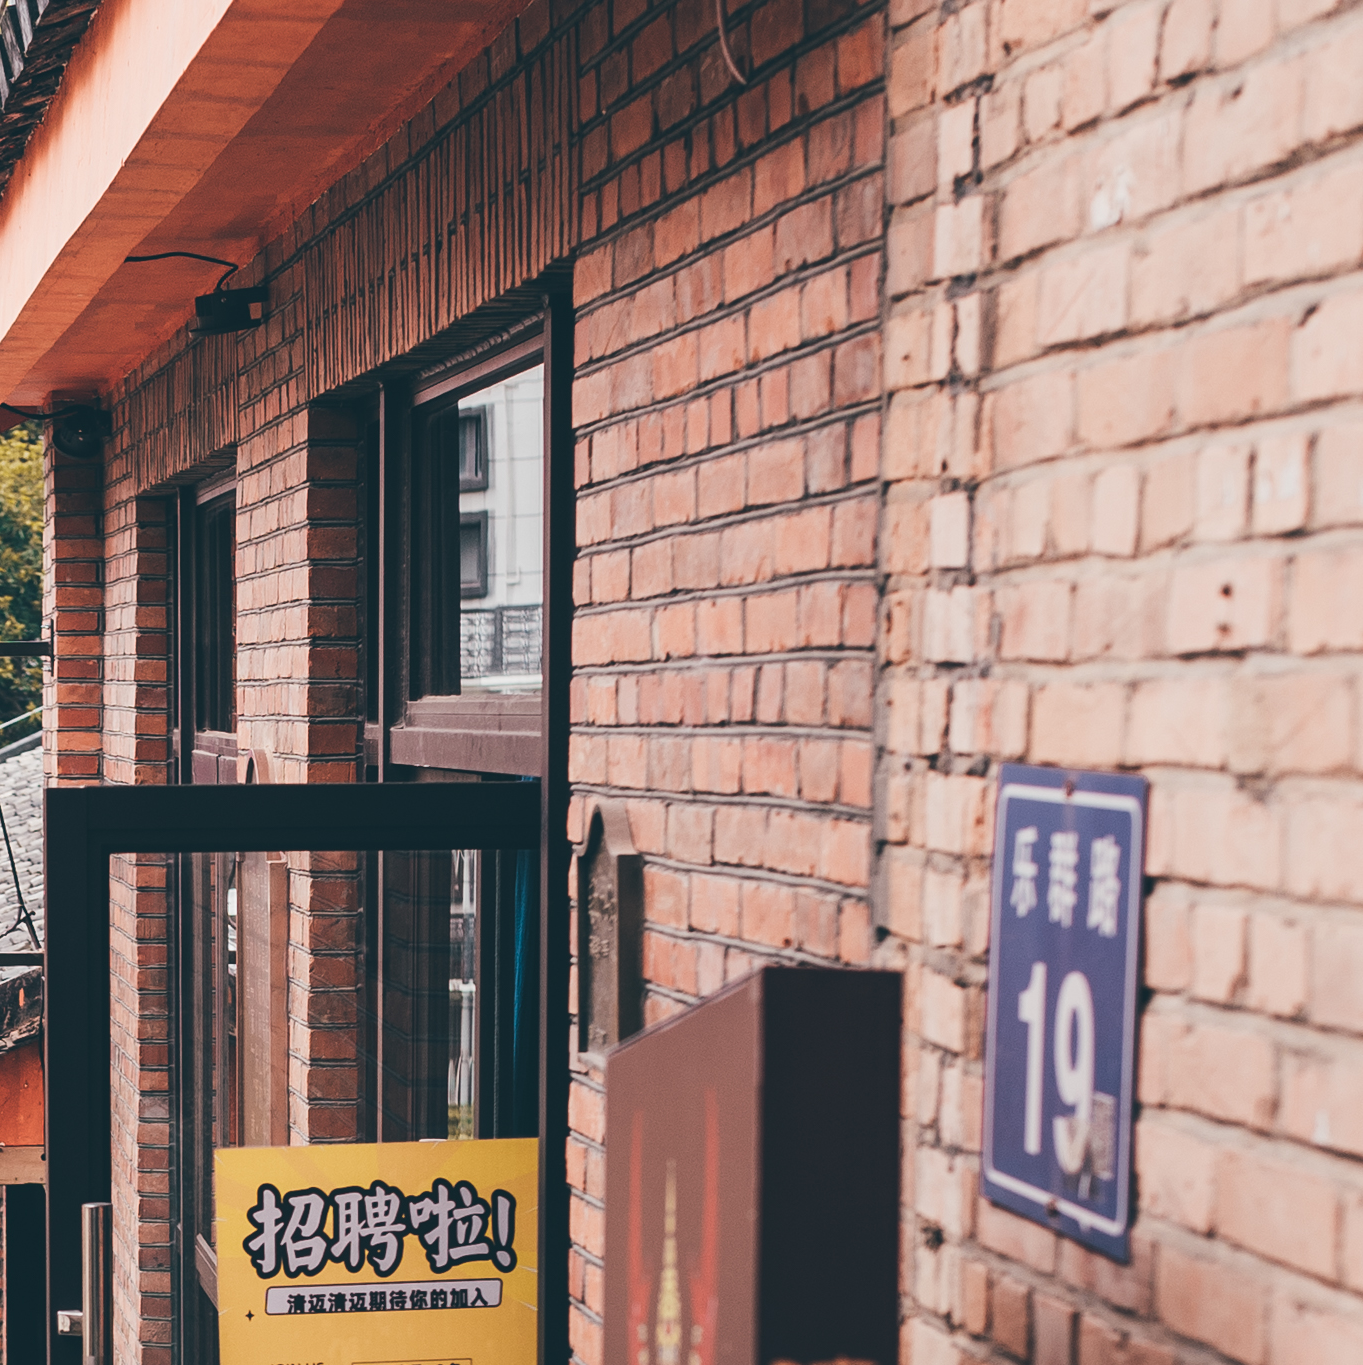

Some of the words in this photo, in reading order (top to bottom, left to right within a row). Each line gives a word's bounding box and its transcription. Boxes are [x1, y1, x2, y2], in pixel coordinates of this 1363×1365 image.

[1017, 961, 1095, 1176] 19
[243, 1178, 517, 1279] 招聘啦!
[287, 1287, 488, 1314] 清迈清迈期待你的加入
